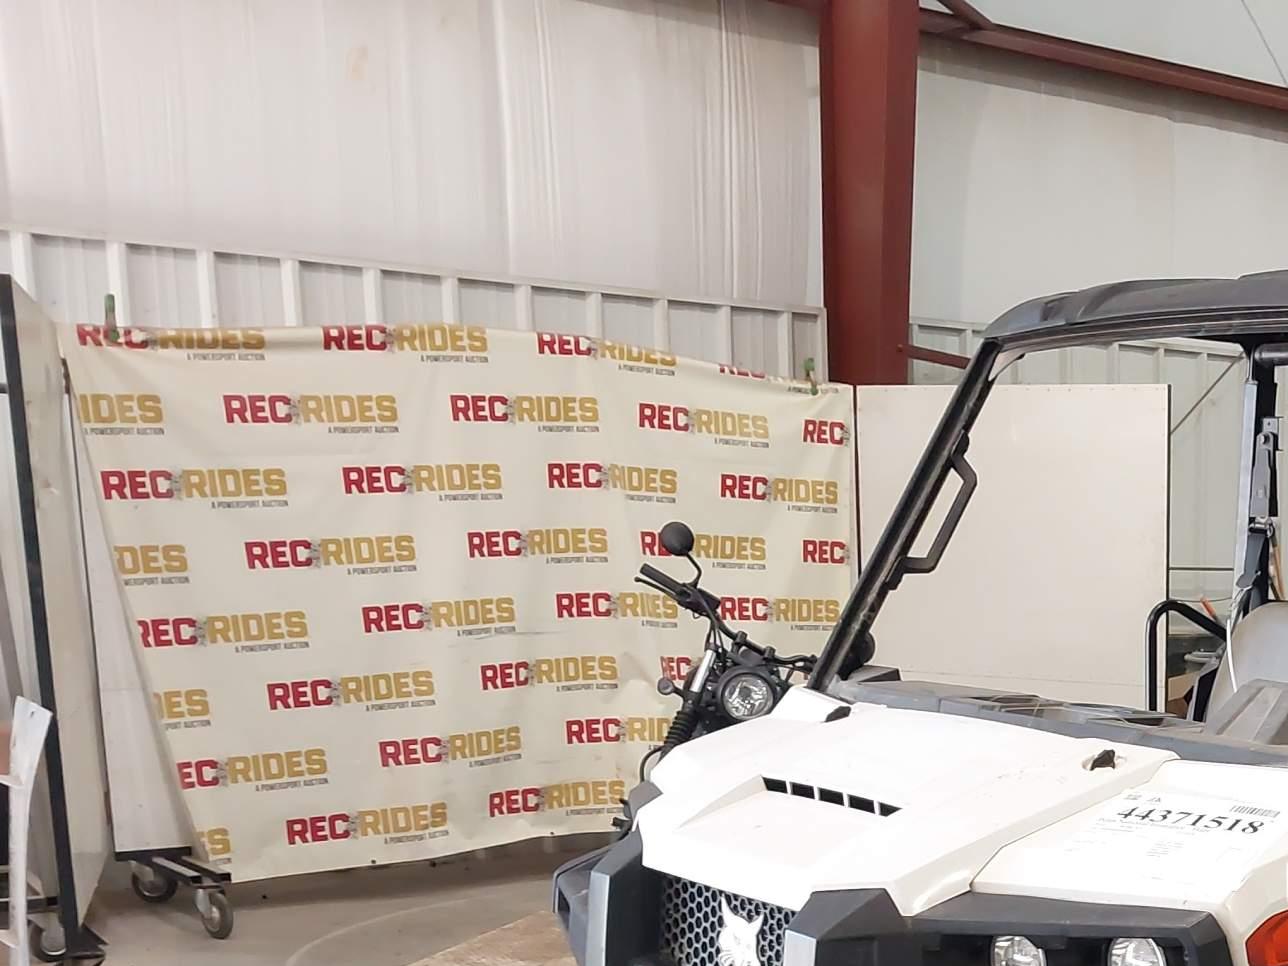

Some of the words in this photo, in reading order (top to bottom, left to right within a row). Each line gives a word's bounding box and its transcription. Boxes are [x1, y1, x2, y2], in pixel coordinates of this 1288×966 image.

[323, 326, 388, 351] REC
[395, 325, 488, 353] RIDES
[537, 333, 592, 356] REC
[224, 396, 292, 423] REC
[300, 395, 398, 423] RIDES
[451, 395, 509, 422] REC
[515, 396, 599, 422] RIDES
[639, 403, 689, 432] REC
[695, 409, 769, 438] RIDES
[804, 419, 847, 445] REC
[101, 470, 174, 500] REC
[183, 469, 287, 498] RIDES
[343, 466, 407, 494] REC
[412, 464, 502, 492] RIDES
[548, 463, 603, 489] REC
[721, 474, 768, 500] REC
[773, 478, 839, 504] RIDES
[246, 539, 313, 569] REC
[320, 535, 416, 565] RIDES
[468, 530, 522, 558] REC
[528, 528, 608, 554] RIDES
[695, 534, 766, 561] RIDES
[803, 540, 846, 564] REC
[363, 603, 425, 633] REC
[432, 598, 516, 628] RIDES
[556, 593, 612, 618] REC
[720, 596, 768, 620] REC
[775, 599, 840, 623] RIDES
[206, 611, 308, 643] RIDES
[481, 663, 528, 689] REC
[534, 656, 619, 684] RIDES
[267, 679, 334, 710] REC
[340, 671, 434, 703] RIDES
[566, 718, 620, 744] REC
[380, 737, 443, 767] REC
[449, 726, 521, 759] RIDES
[228, 749, 328, 784] RIDES
[489, 787, 540, 816] REC
[545, 780, 624, 809] RIDES
[286, 813, 351, 844] REC
[358, 802, 448, 837] RIDES
[1117, 807, 1265, 834] 44371518
